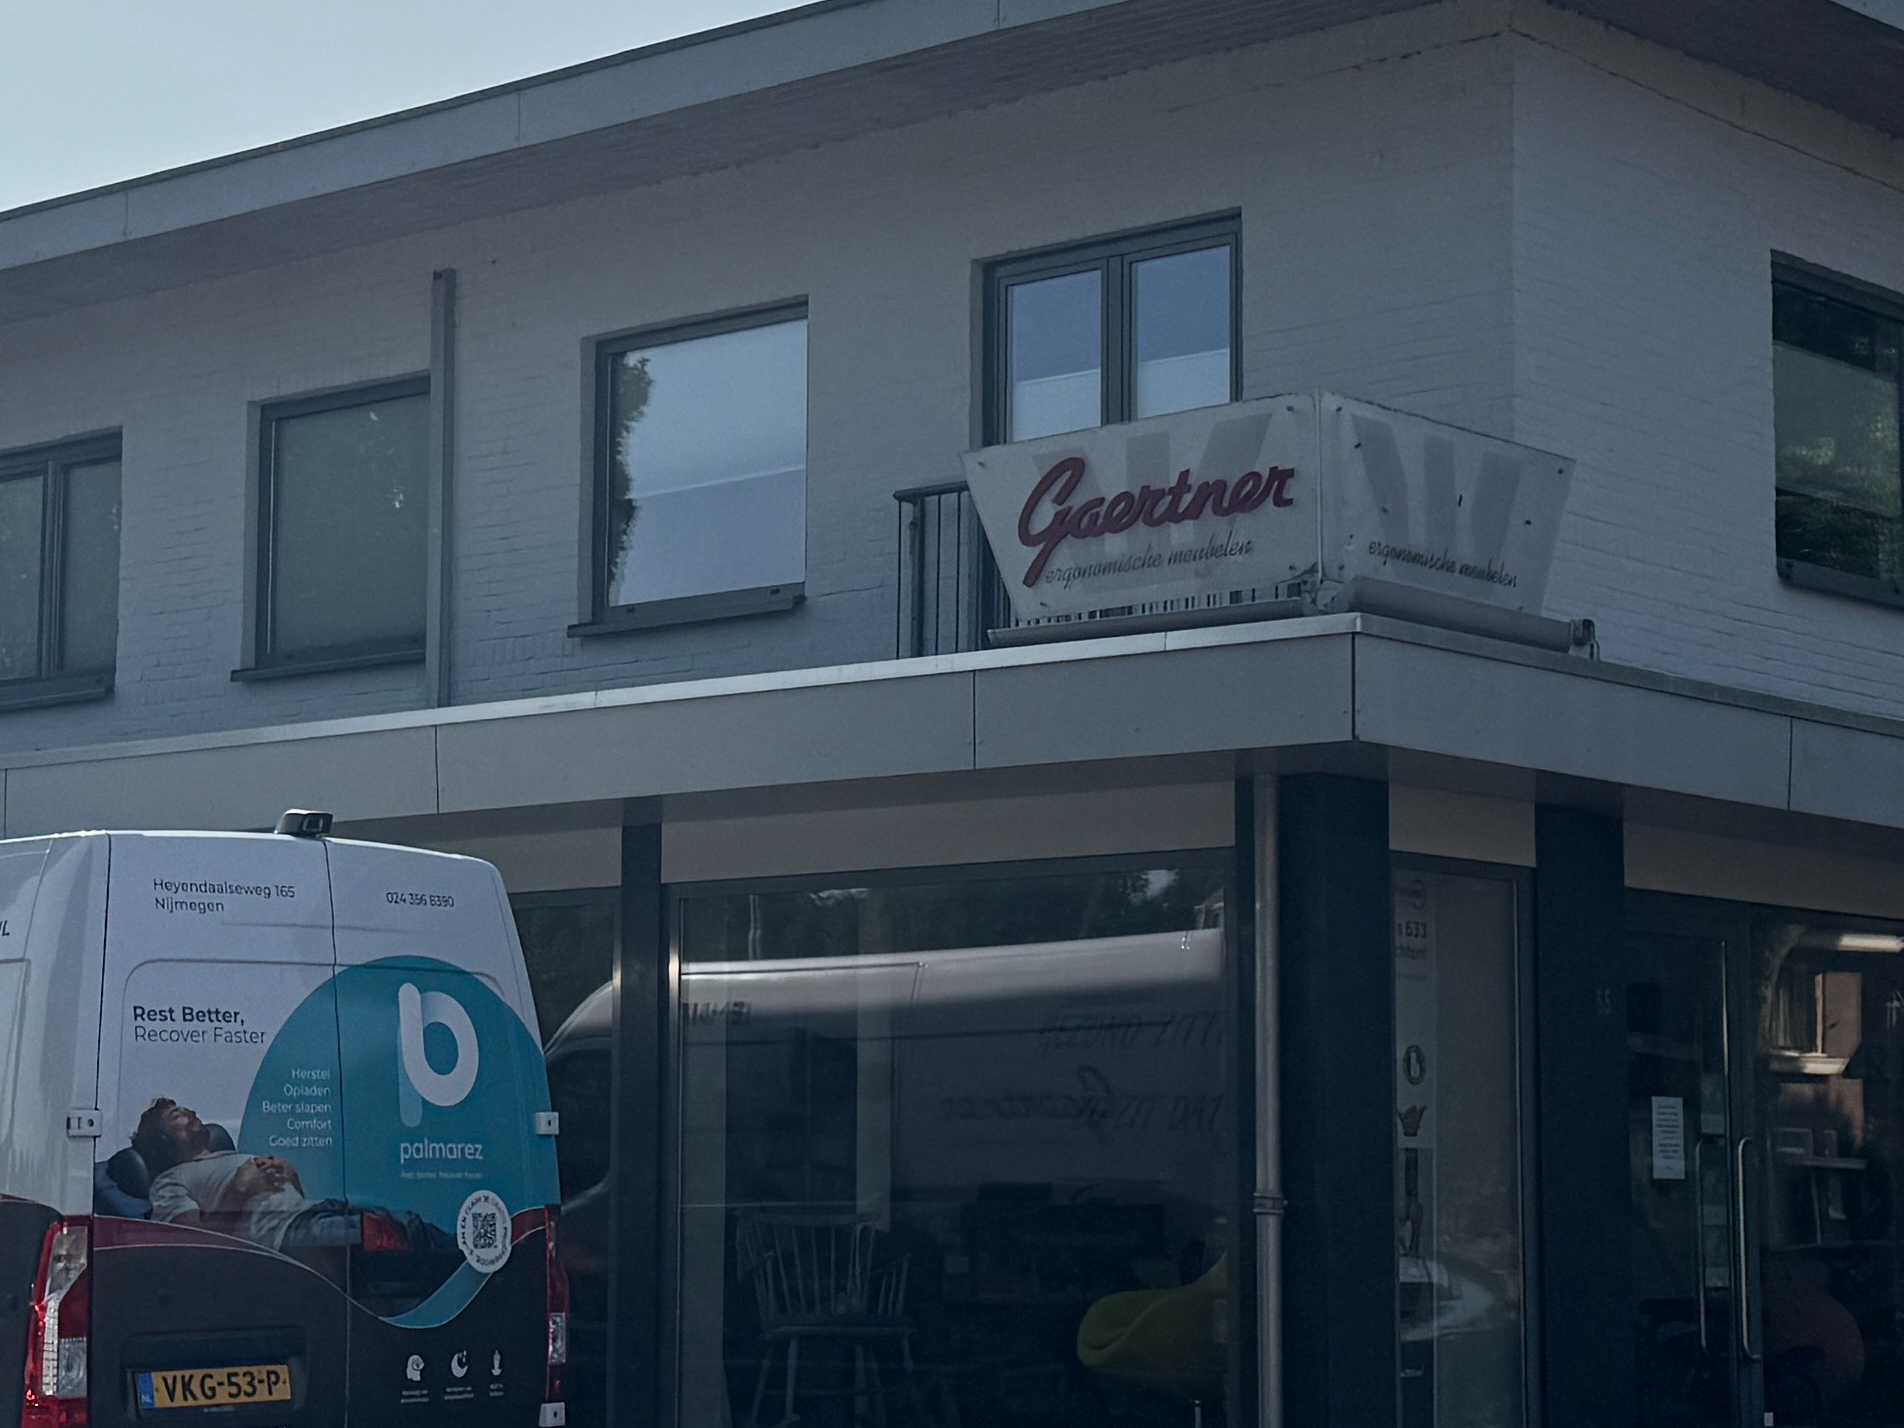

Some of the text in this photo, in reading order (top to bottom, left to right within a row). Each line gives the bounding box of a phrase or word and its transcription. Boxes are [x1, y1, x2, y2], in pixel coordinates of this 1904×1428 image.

[1017, 456, 1295, 588] Gaertner
[1046, 530, 1253, 589] ergonomische meubelen
[1369, 541, 1517, 588] ergonomische meubelen
[153, 878, 295, 899] Heyendaalseweg 165
[156, 898, 224, 914] Nijmegen
[386, 892, 406, 905] 024
[409, 893, 427, 906] 356
[133, 1005, 245, 1027] Rest Better,
[134, 1025, 267, 1044] Recover Faster
[292, 1068, 330, 1081] Herstel
[284, 1083, 331, 1098] Opladen
[262, 1101, 332, 1116] Beter slapen
[287, 1117, 332, 1130] Comfort
[269, 1134, 333, 1147] Goed zitten
[400, 1137, 483, 1164] palmarez
[162, 1370, 280, 1403] VKG-53-P
